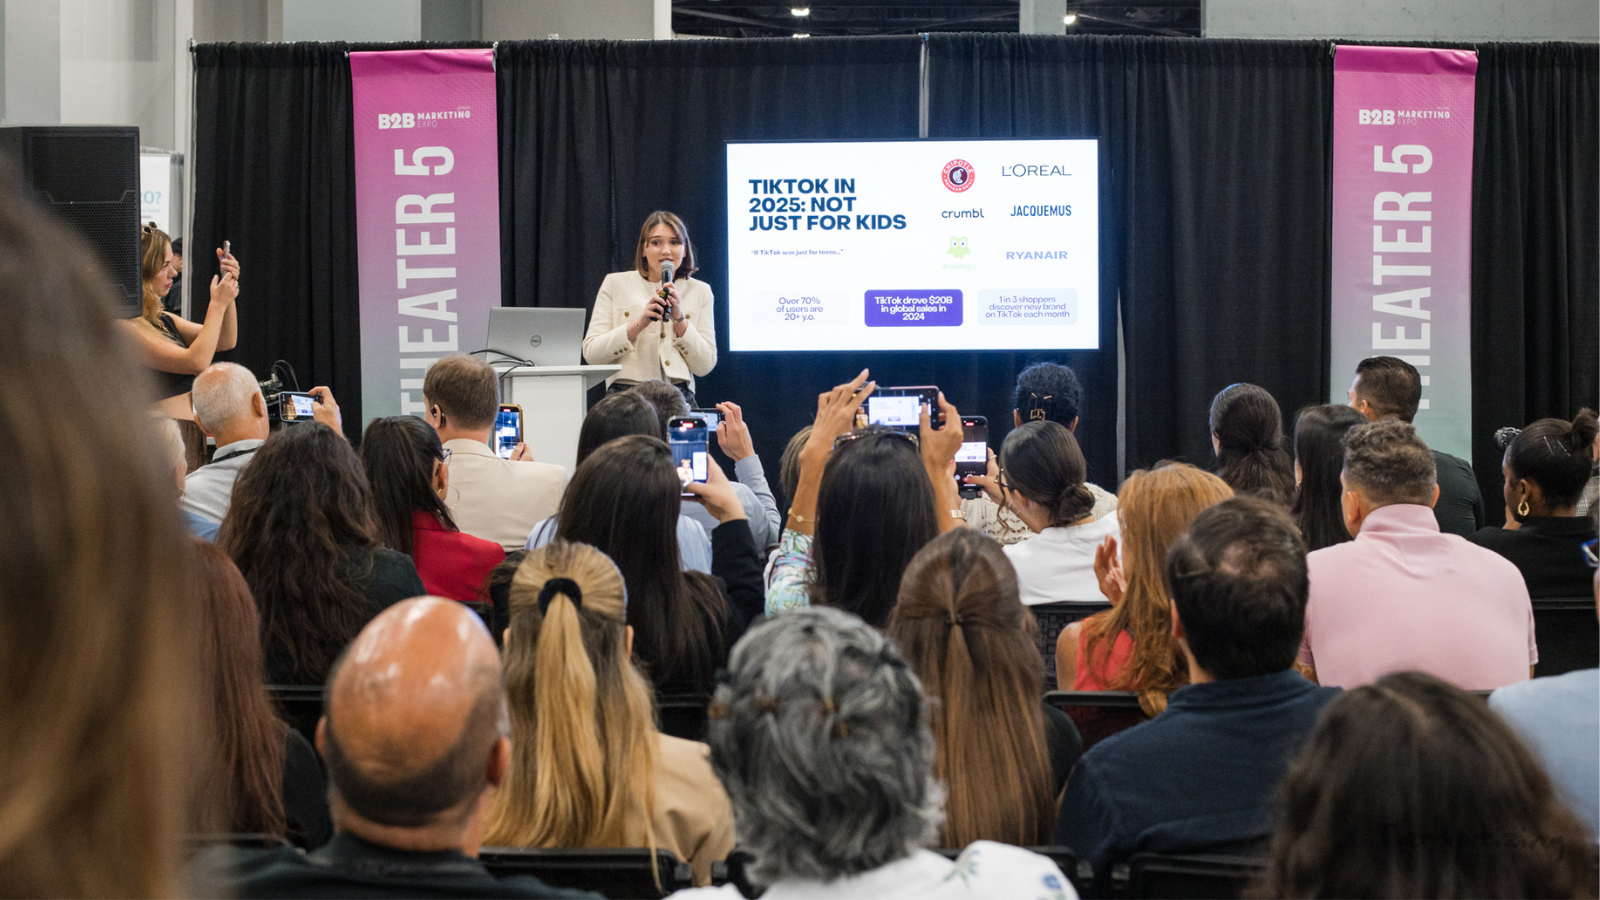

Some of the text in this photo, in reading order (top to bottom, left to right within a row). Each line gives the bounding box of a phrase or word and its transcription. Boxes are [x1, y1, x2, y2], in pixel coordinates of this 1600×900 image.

[417, 110, 471, 120] MARKETING
[1358, 109, 1396, 126] B2B
[1397, 110, 1450, 119] MARKETING
[378, 112, 416, 130] B2B
[417, 120, 438, 128] EXPO
[394, 146, 455, 176] 5
[943, 160, 974, 174] CHIPOTLE
[748, 178, 856, 194] TIKTOK IN
[749, 196, 857, 213] 2025: NOT
[941, 208, 984, 218] crumbl
[1010, 204, 1072, 216] JACQUEMUS
[749, 214, 907, 231] JUST FOR KIDS
[1006, 251, 1068, 260] RYANAIR
[942, 262, 977, 272] duolingo
[1372, 144, 1433, 410] EATER 5
[874, 295, 953, 305] TikTok drove $20B
[1018, 296, 1056, 304] shoppers
[890, 304, 915, 314] global
[939, 304, 947, 312] in
[802, 314, 815, 322] y.o.
[902, 312, 926, 320] 2024
